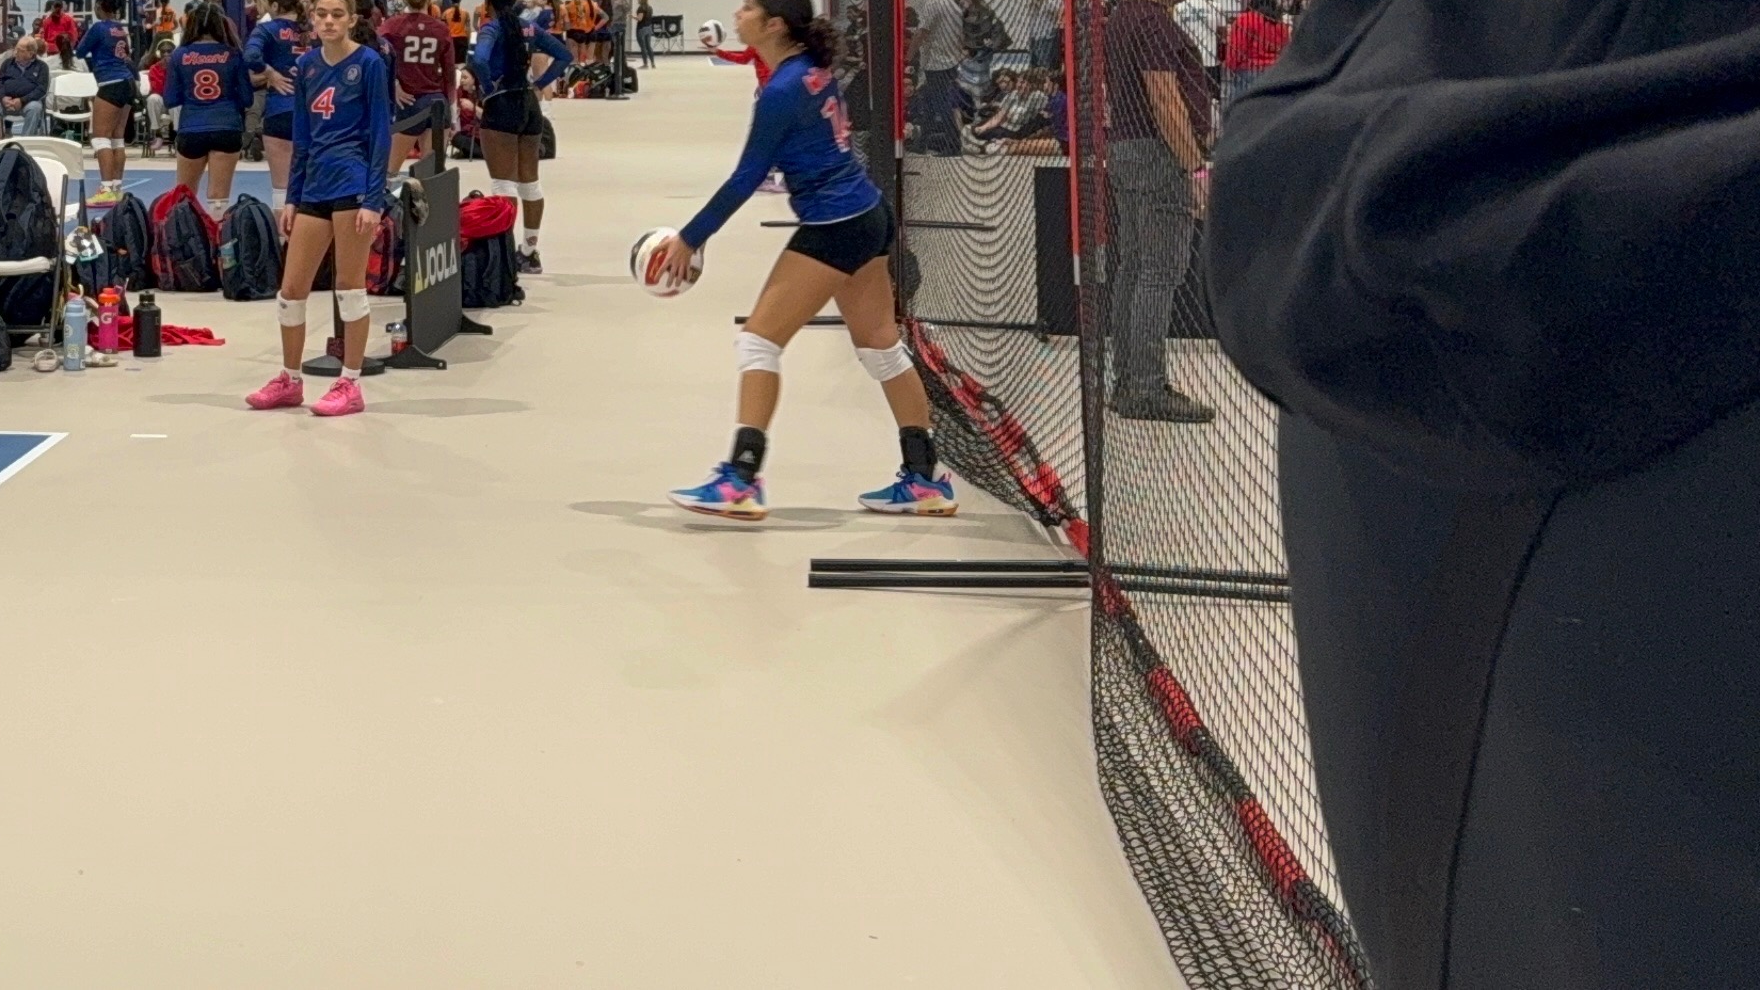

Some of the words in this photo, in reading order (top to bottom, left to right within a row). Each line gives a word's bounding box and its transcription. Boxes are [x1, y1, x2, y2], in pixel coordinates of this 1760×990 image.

[403, 35, 438, 65] 22
[193, 68, 222, 101] 8
[311, 86, 336, 120] 4
[424, 238, 458, 290] JOOLA
[101, 312, 113, 324] G
